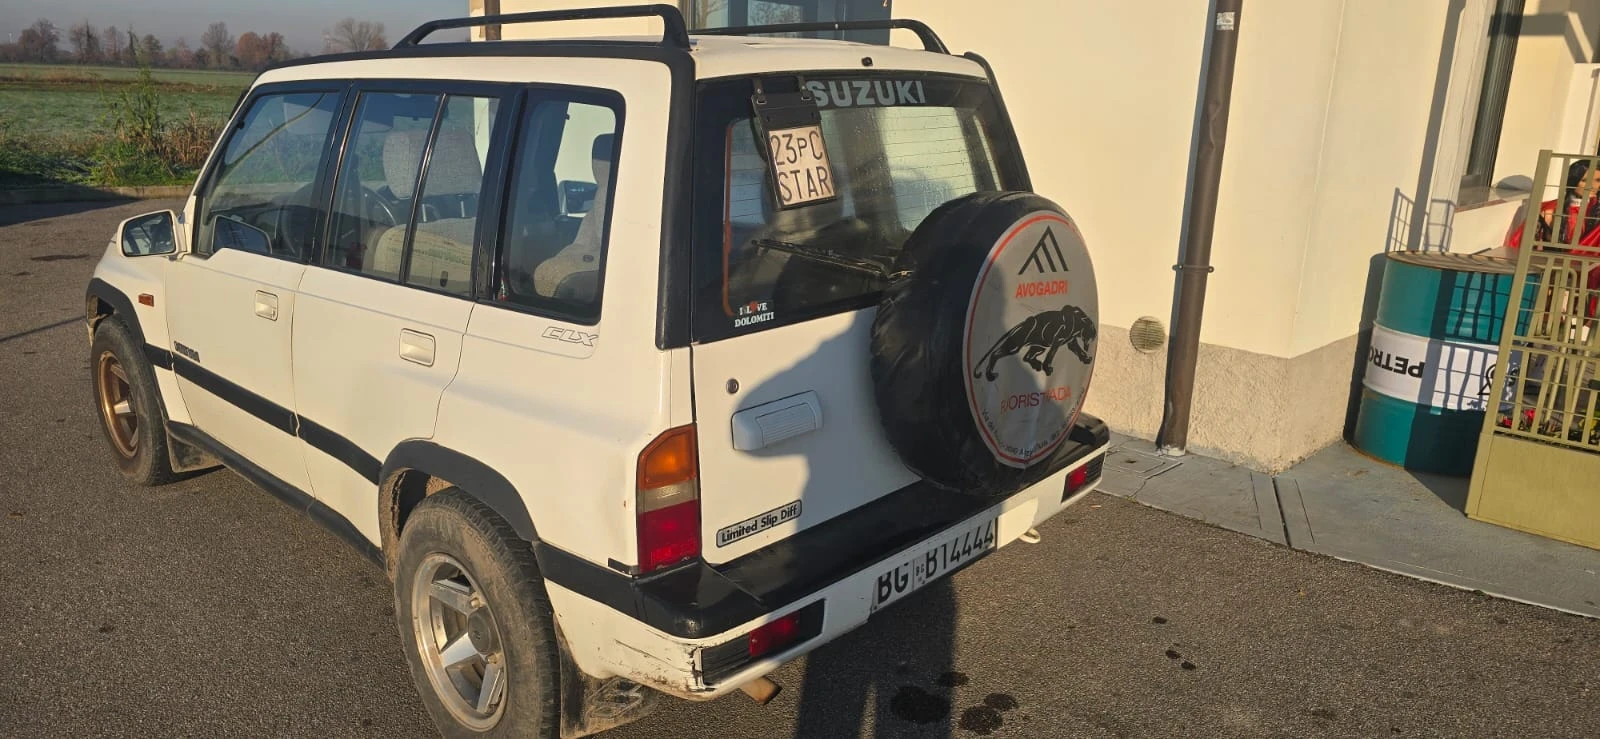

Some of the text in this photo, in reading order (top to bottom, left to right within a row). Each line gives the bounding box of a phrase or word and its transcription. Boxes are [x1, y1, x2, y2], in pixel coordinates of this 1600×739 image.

[805, 80, 926, 107] SUZUKI
[770, 131, 823, 165] 23PC
[778, 166, 831, 202] STAR
[1015, 280, 1069, 299] AVOGADRI
[734, 311, 775, 328] DOLOMITI
[739, 301, 768, 316] I LVE
[541, 326, 599, 347] CLX
[1000, 386, 1071, 415] FORISTADA
[721, 504, 798, 543] Limited Slip Diff
[877, 562, 909, 605] BG
[926, 519, 994, 579] B14444
